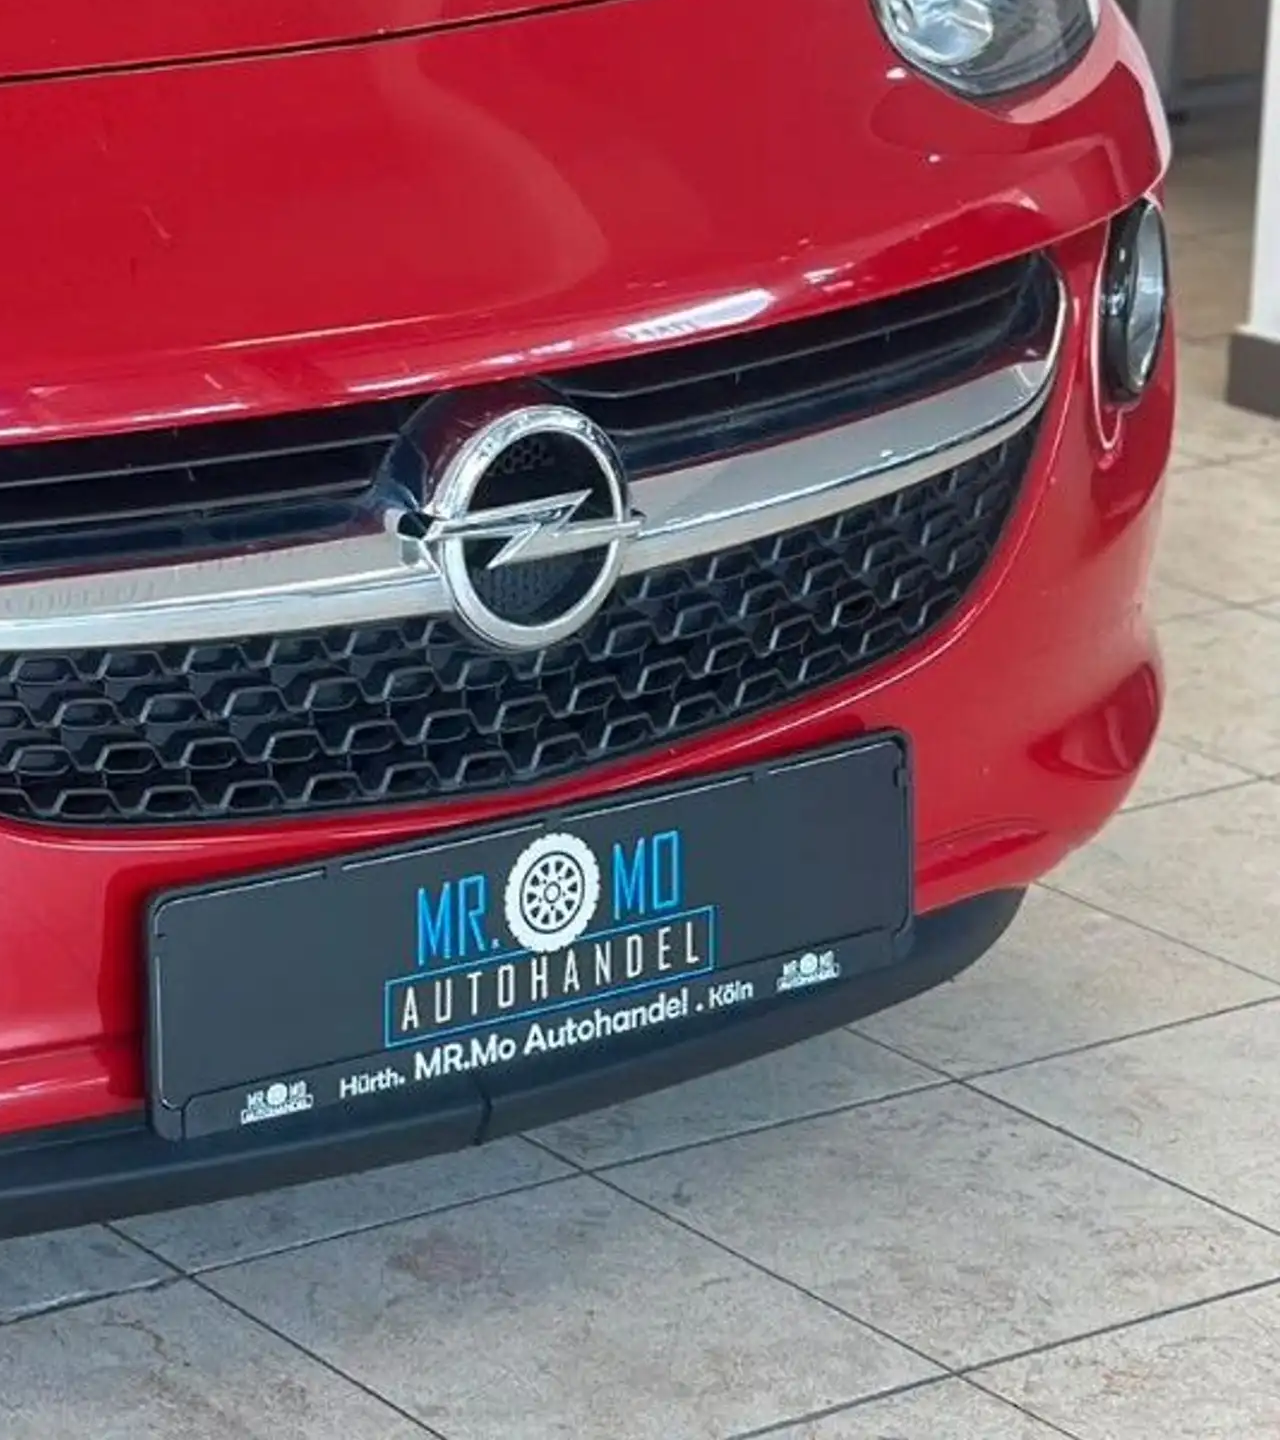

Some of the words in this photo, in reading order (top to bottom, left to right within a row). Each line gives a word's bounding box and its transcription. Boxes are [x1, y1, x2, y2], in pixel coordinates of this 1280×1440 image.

[416, 873, 500, 967] MR.
[612, 829, 679, 921] MO
[400, 921, 700, 1033] AUTOHANDEL
[413, 1035, 516, 1082] MR.Mo
[523, 989, 688, 1056] Autohandel
[707, 979, 754, 1010] Köln
